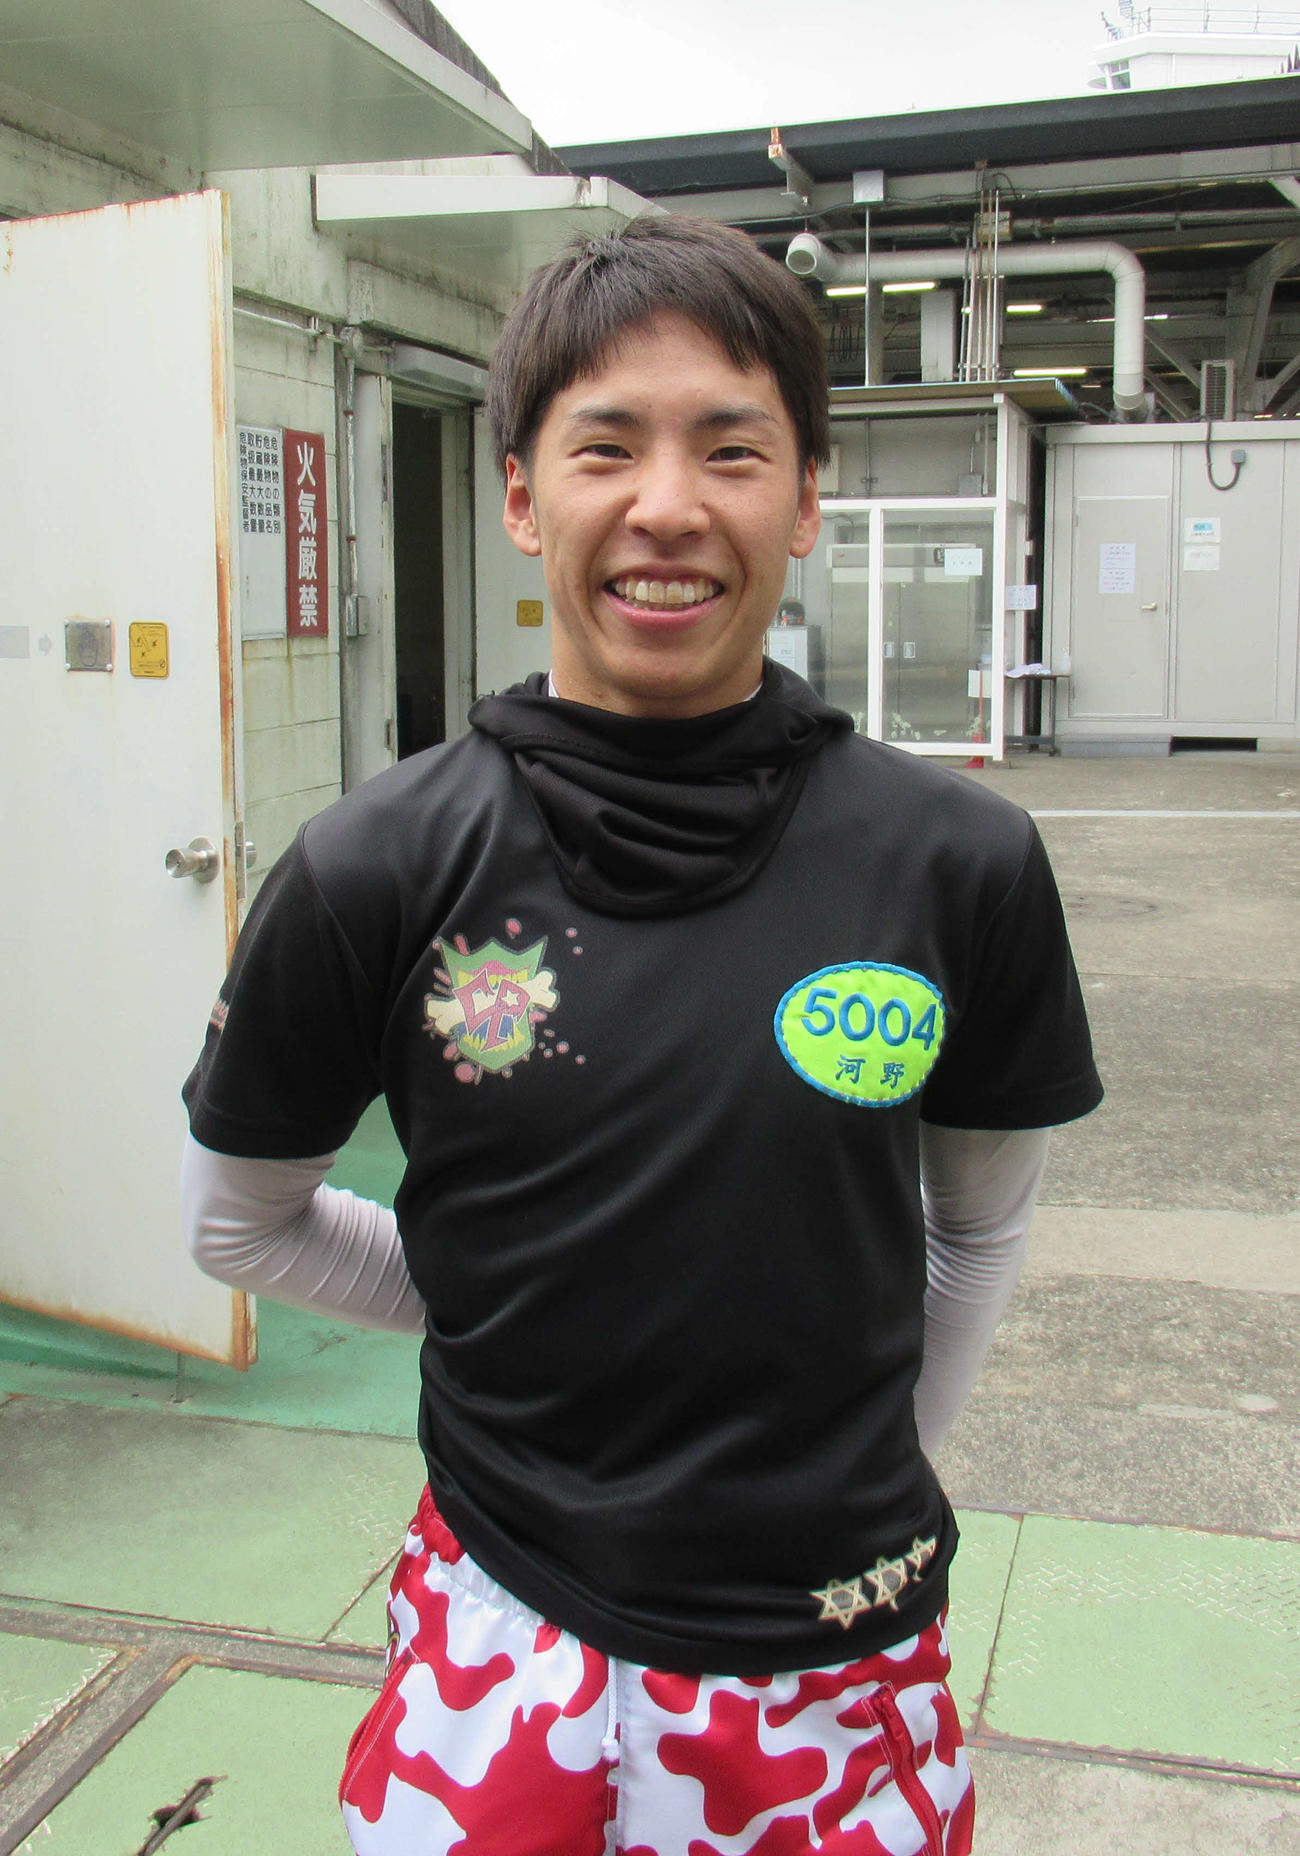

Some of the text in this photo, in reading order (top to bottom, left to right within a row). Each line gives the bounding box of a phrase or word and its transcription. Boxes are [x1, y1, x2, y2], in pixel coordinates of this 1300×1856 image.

[297, 441, 318, 627] 火気厳禁
[801, 987, 937, 1051] 5004
